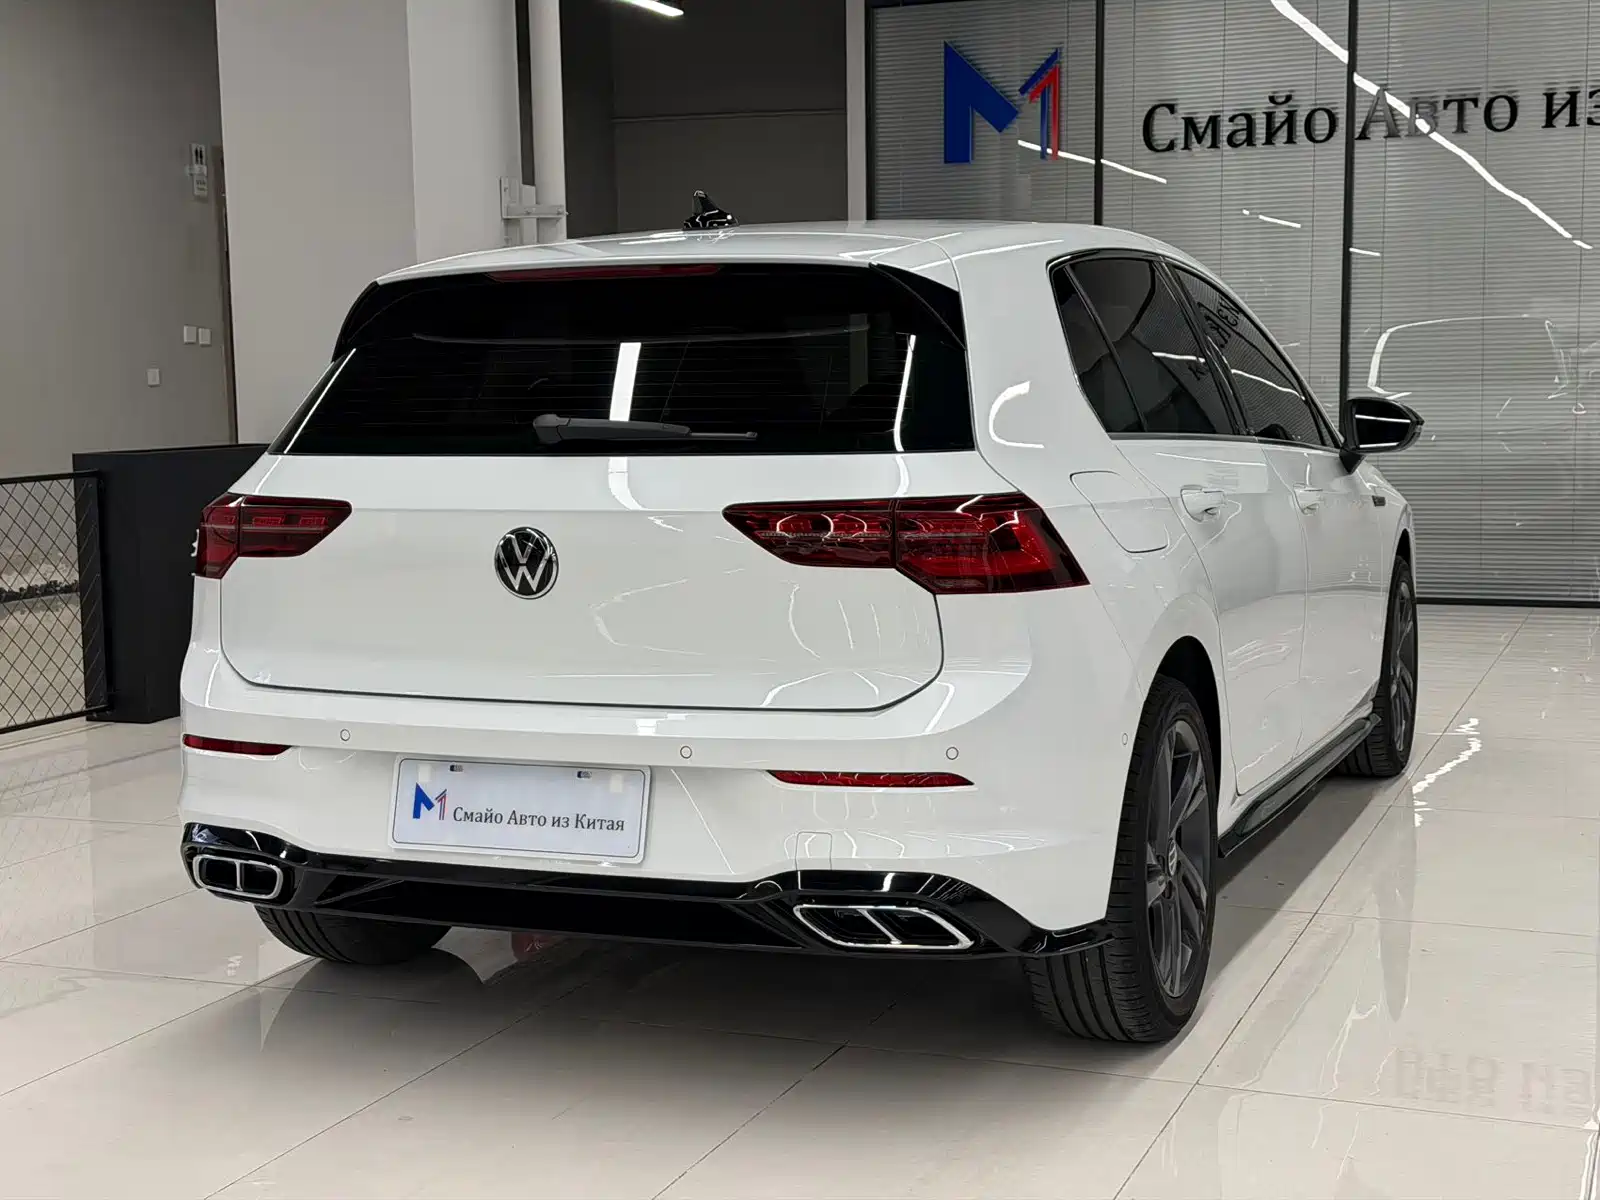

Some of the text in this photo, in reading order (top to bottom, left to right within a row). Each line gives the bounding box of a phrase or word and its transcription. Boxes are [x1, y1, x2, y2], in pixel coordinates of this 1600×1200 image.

[1142, 93, 1337, 153] Смайо
[1354, 86, 1519, 141] Авто
[453, 806, 625, 831] Смайо Авто из Китая
